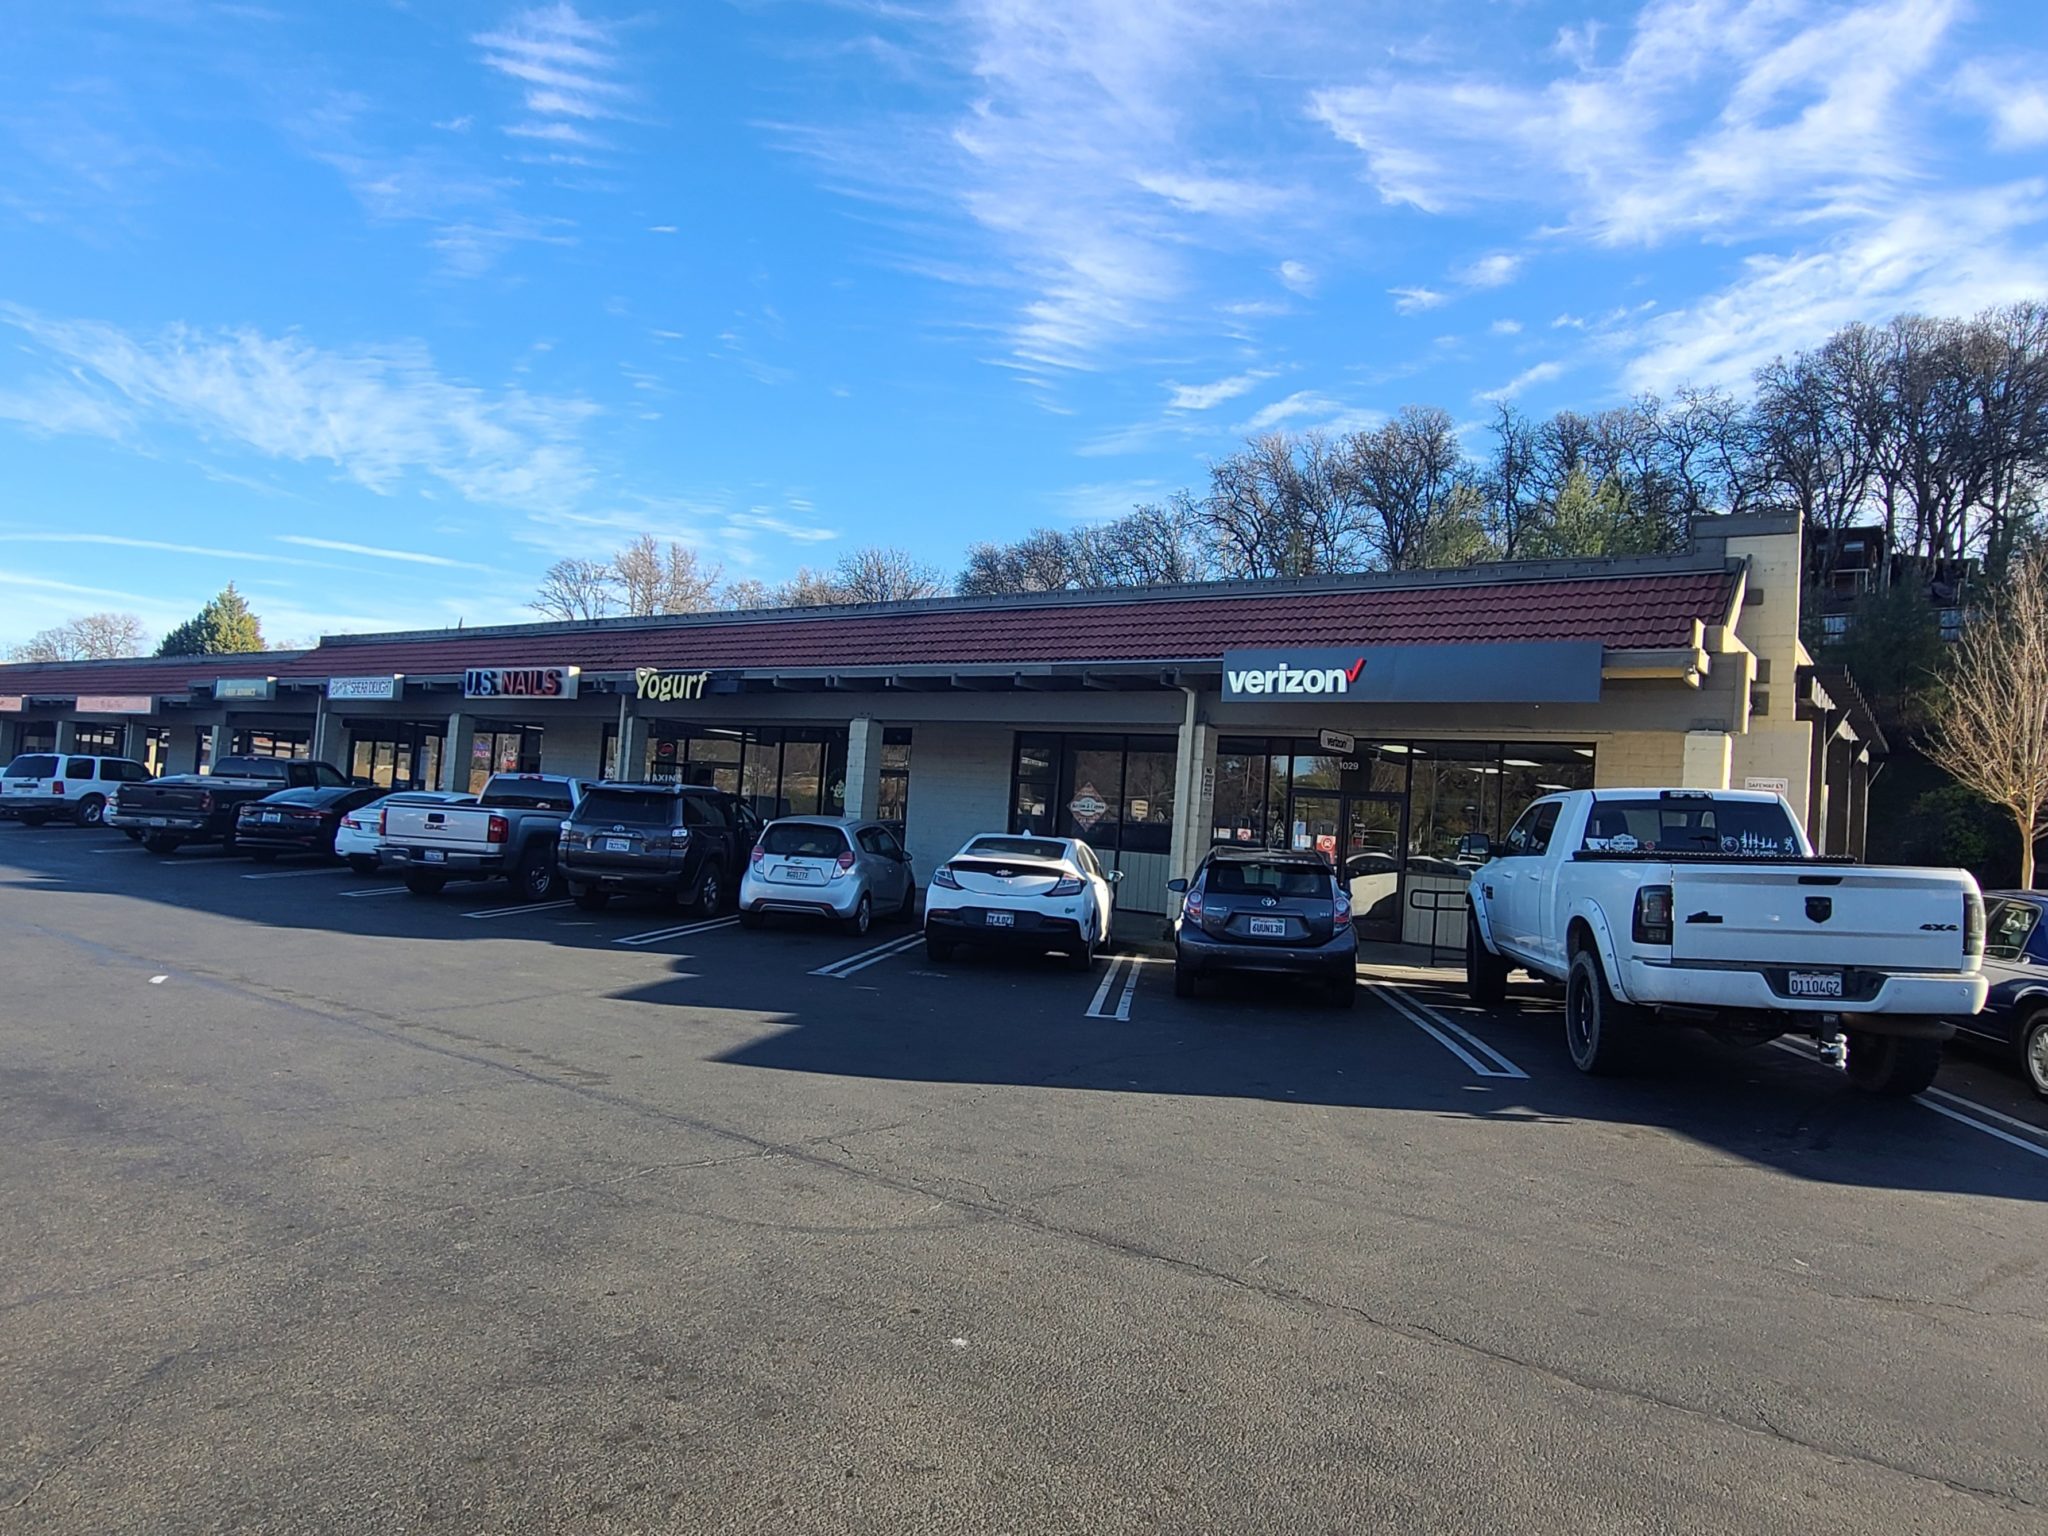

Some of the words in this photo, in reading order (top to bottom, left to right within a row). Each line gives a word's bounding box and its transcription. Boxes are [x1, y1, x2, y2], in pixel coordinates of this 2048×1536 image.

[465, 671, 496, 696] U.S.
[502, 669, 560, 696] NAILS
[635, 667, 713, 702] Yogurt
[1227, 662, 1348, 694] verizon
[350, 681, 368, 694] SHEAR
[368, 680, 392, 695] DELIGHT
[1326, 736, 1347, 748] verizon
[1339, 762, 1359, 770] 1029
[424, 823, 449, 831] GMC
